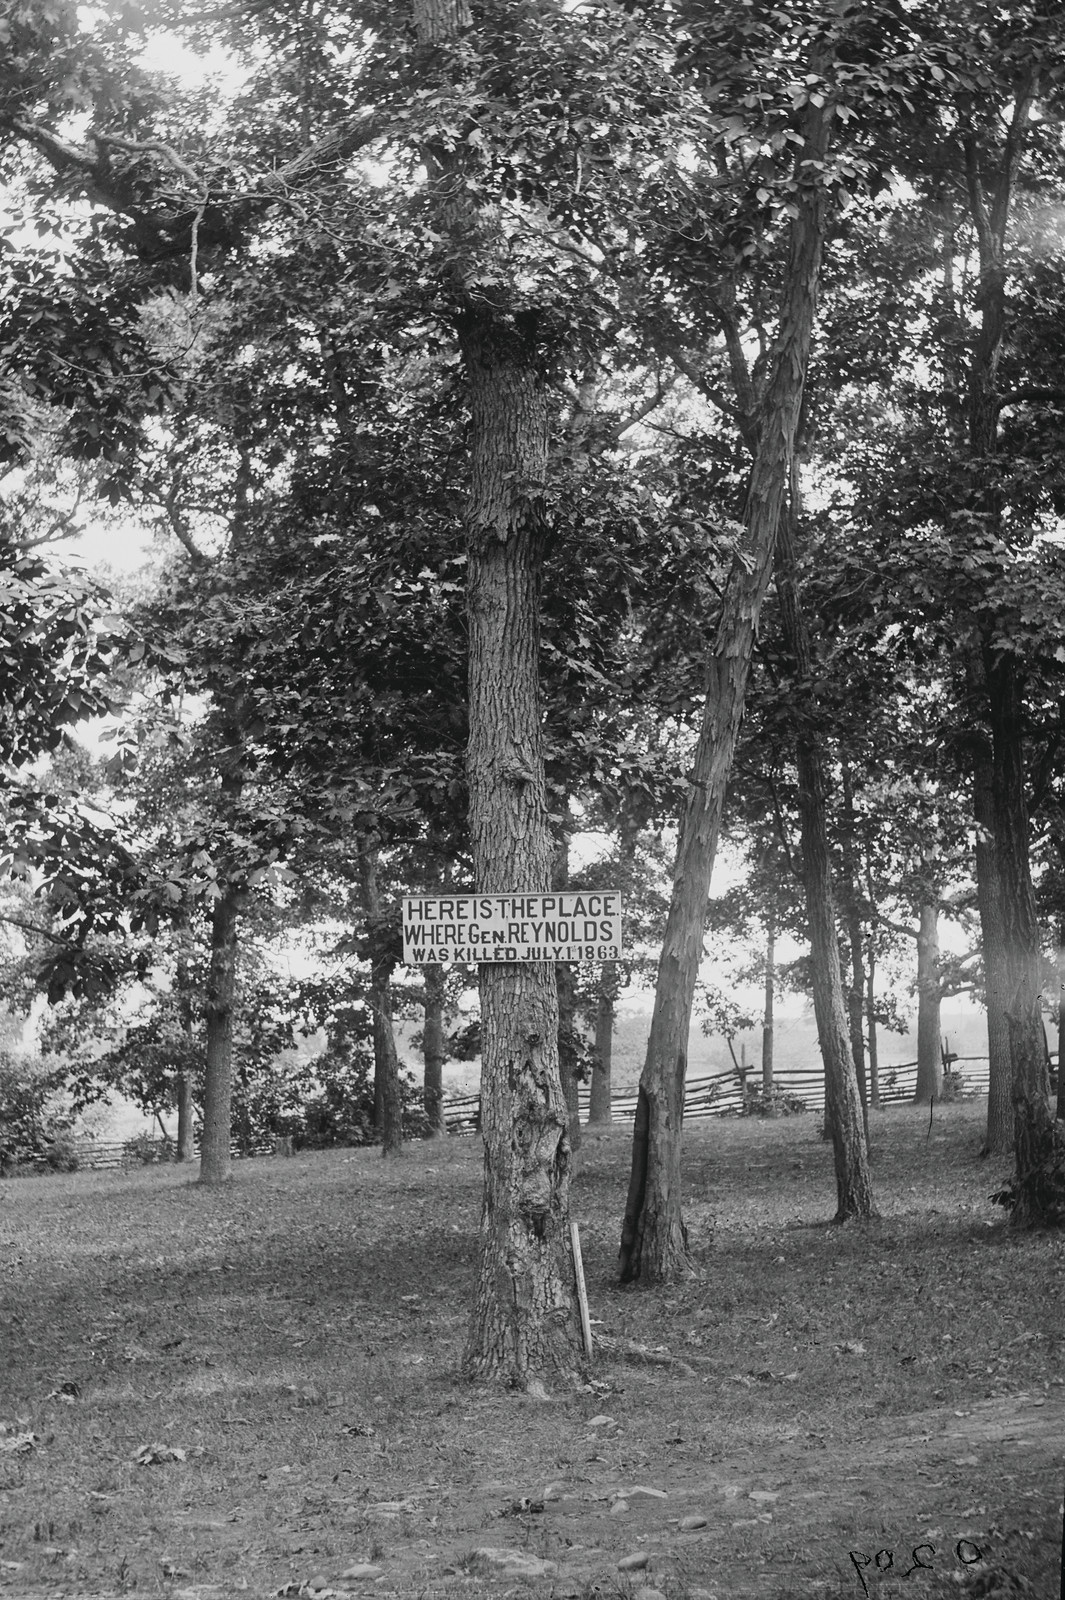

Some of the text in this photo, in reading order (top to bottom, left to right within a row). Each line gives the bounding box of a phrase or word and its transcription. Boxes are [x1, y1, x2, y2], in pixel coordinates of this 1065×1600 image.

[408, 899, 469, 920] HERE
[473, 899, 493, 919] IS
[496, 898, 538, 919] THE
[404, 924, 466, 945] WHERE
[508, 920, 613, 944] REYNOLDS
[412, 948, 449, 962] WAS
